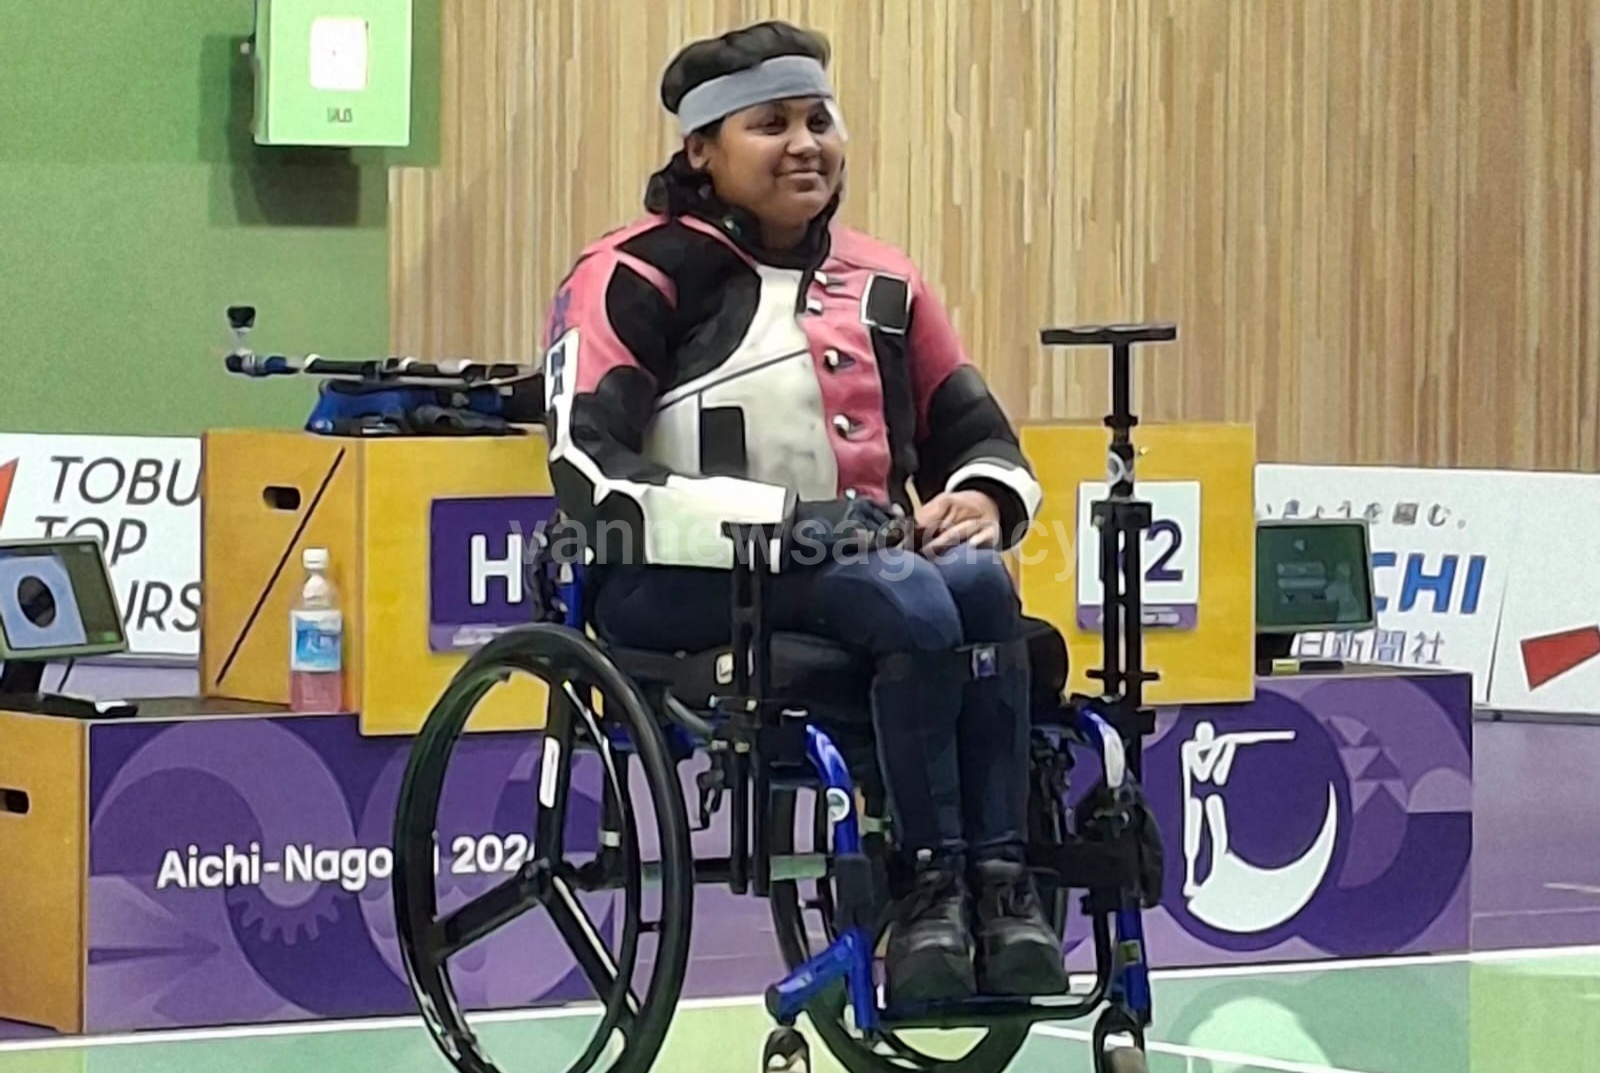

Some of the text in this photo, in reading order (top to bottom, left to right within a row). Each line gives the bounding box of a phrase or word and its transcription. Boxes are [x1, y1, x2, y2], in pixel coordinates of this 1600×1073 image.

[50, 455, 201, 506] TOBU
[471, 534, 522, 604] H
[156, 842, 439, 891] Aichi-Nago
